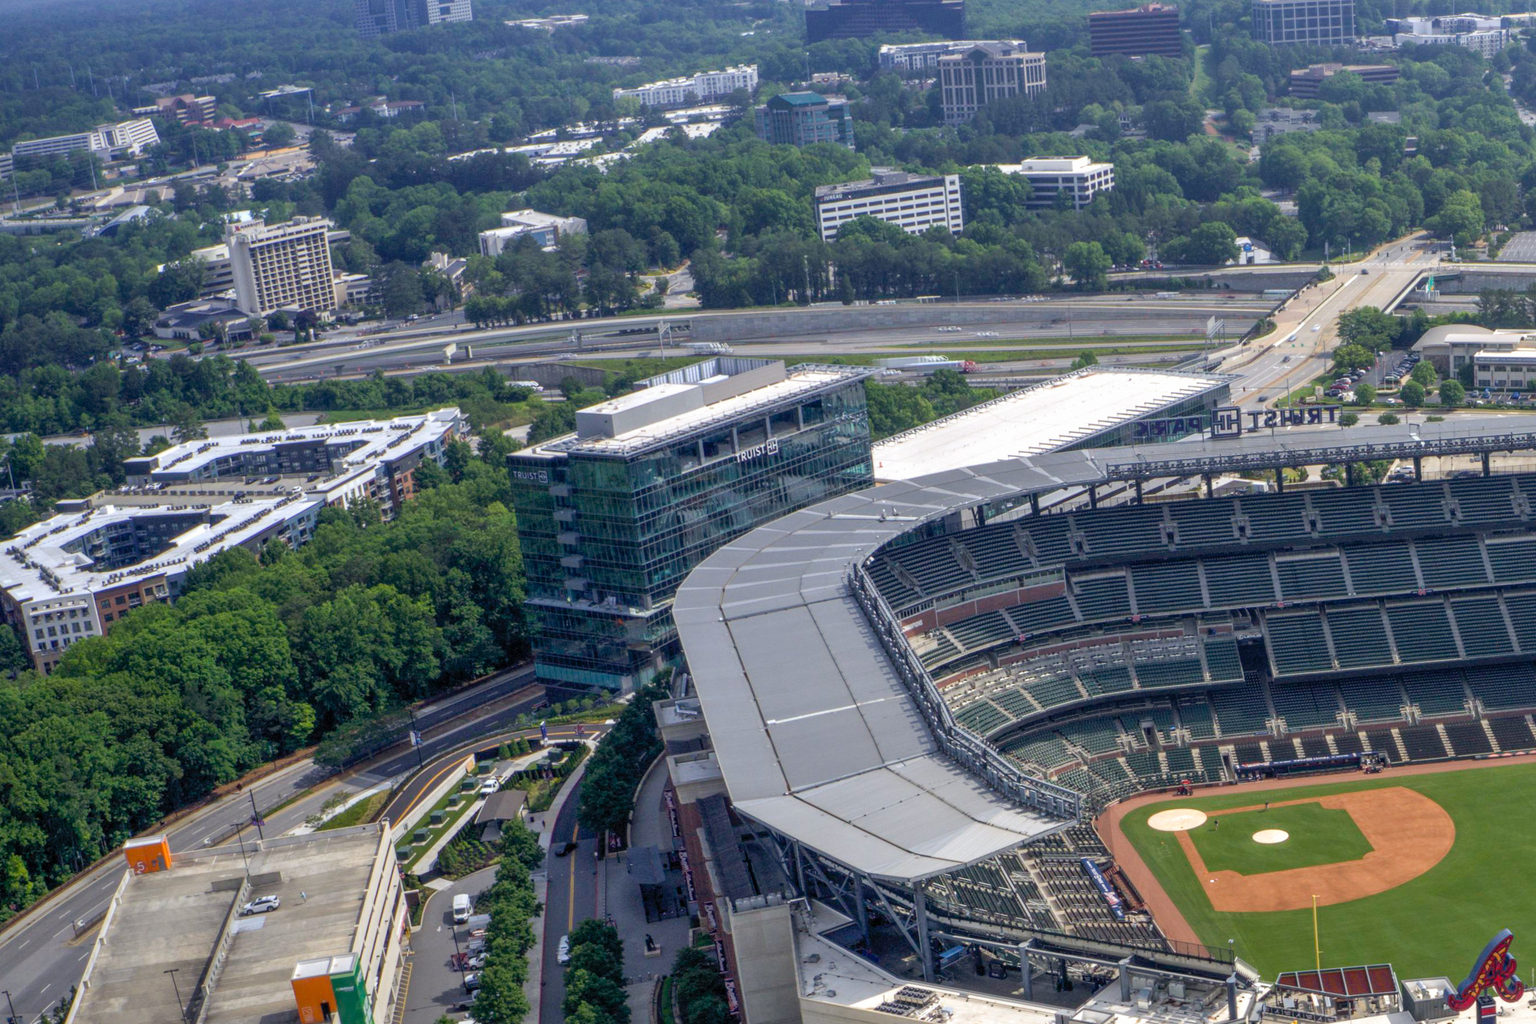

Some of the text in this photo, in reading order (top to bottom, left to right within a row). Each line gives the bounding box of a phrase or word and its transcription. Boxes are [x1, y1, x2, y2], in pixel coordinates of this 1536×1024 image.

[735, 446, 768, 464] TRUIST
[513, 470, 538, 480] TRUIST
[137, 861, 145, 871] 5
